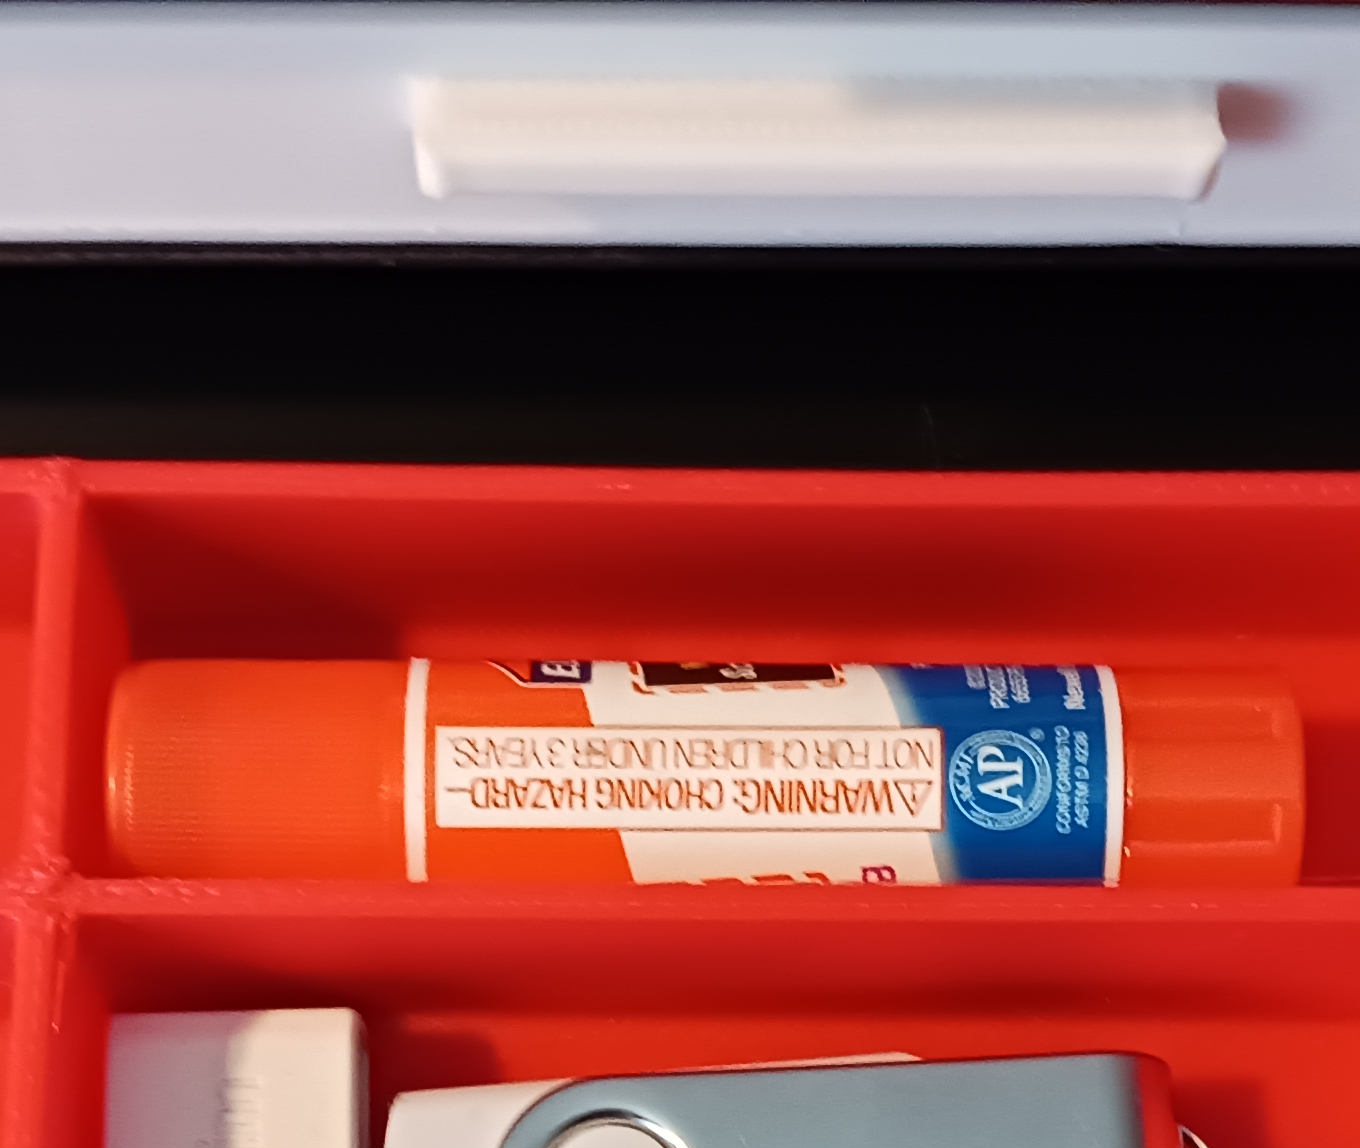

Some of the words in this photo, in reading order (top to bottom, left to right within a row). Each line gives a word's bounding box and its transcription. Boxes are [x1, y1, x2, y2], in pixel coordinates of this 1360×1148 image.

[547, 738, 568, 769] 3
[574, 737, 667, 770] UNDER
[673, 737, 808, 770] CHILDREN
[814, 738, 870, 770] FOR
[875, 738, 935, 770] NOT
[596, 777, 725, 812] CHOKING
[976, 745, 1025, 811] AP
[732, 777, 895, 815] WARNING:
